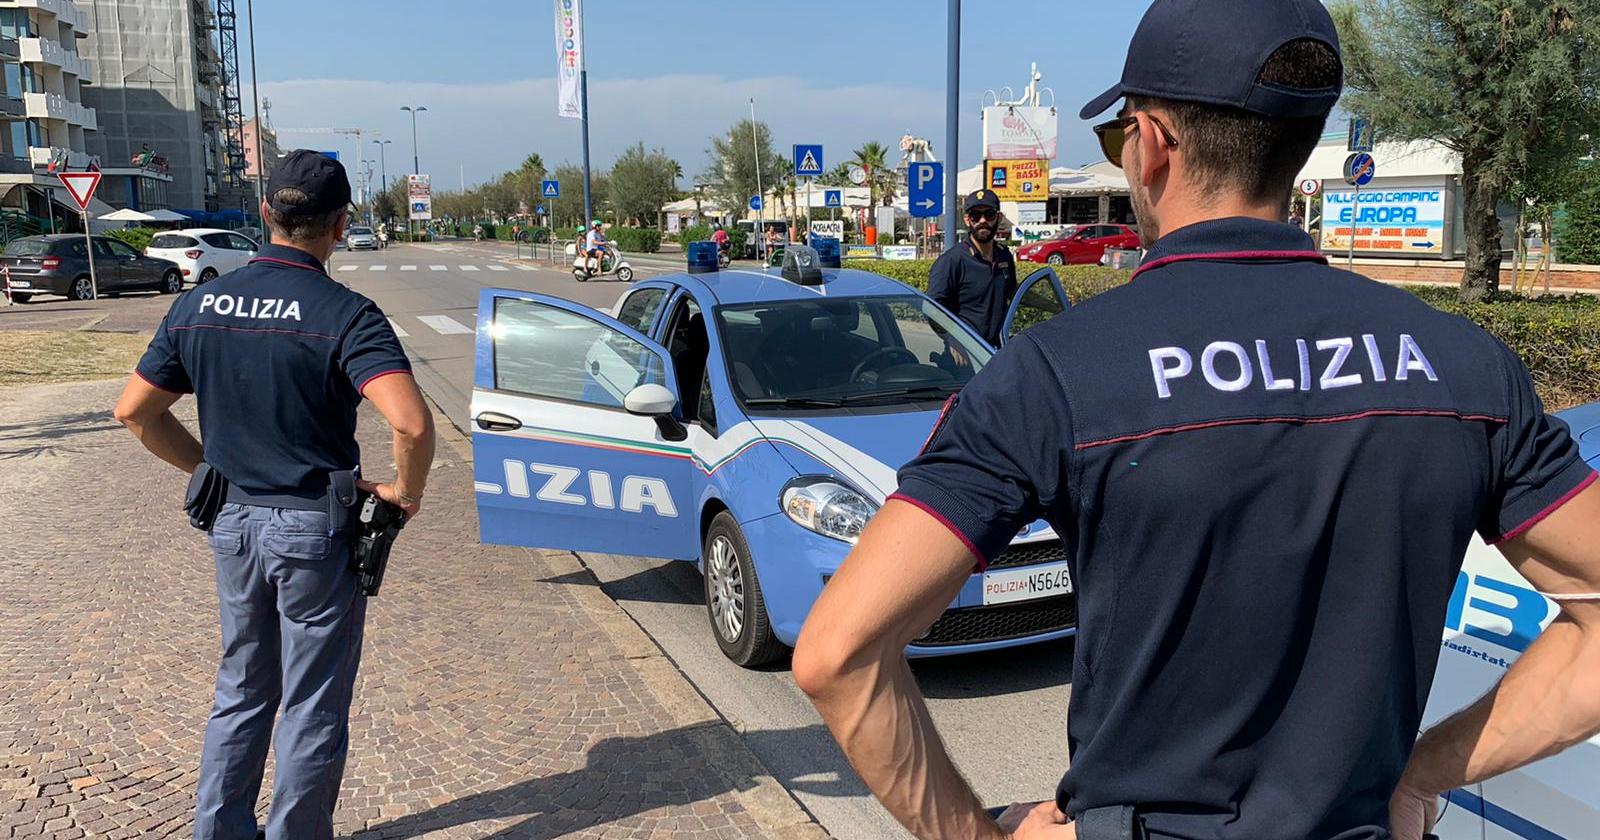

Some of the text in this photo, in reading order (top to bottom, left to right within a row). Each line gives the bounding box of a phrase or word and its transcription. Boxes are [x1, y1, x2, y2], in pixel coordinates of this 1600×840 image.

[1012, 162, 1037, 170] PREZZI
[1016, 170, 1042, 180] BASSI
[918, 165, 934, 190] P
[1306, 182, 1312, 191] 5
[1385, 191, 1439, 202] CAMPING
[199, 293, 302, 321] POLIZIA
[1148, 333, 1439, 399] POLIZIA
[986, 570, 1069, 595] POLIZIA N5646
